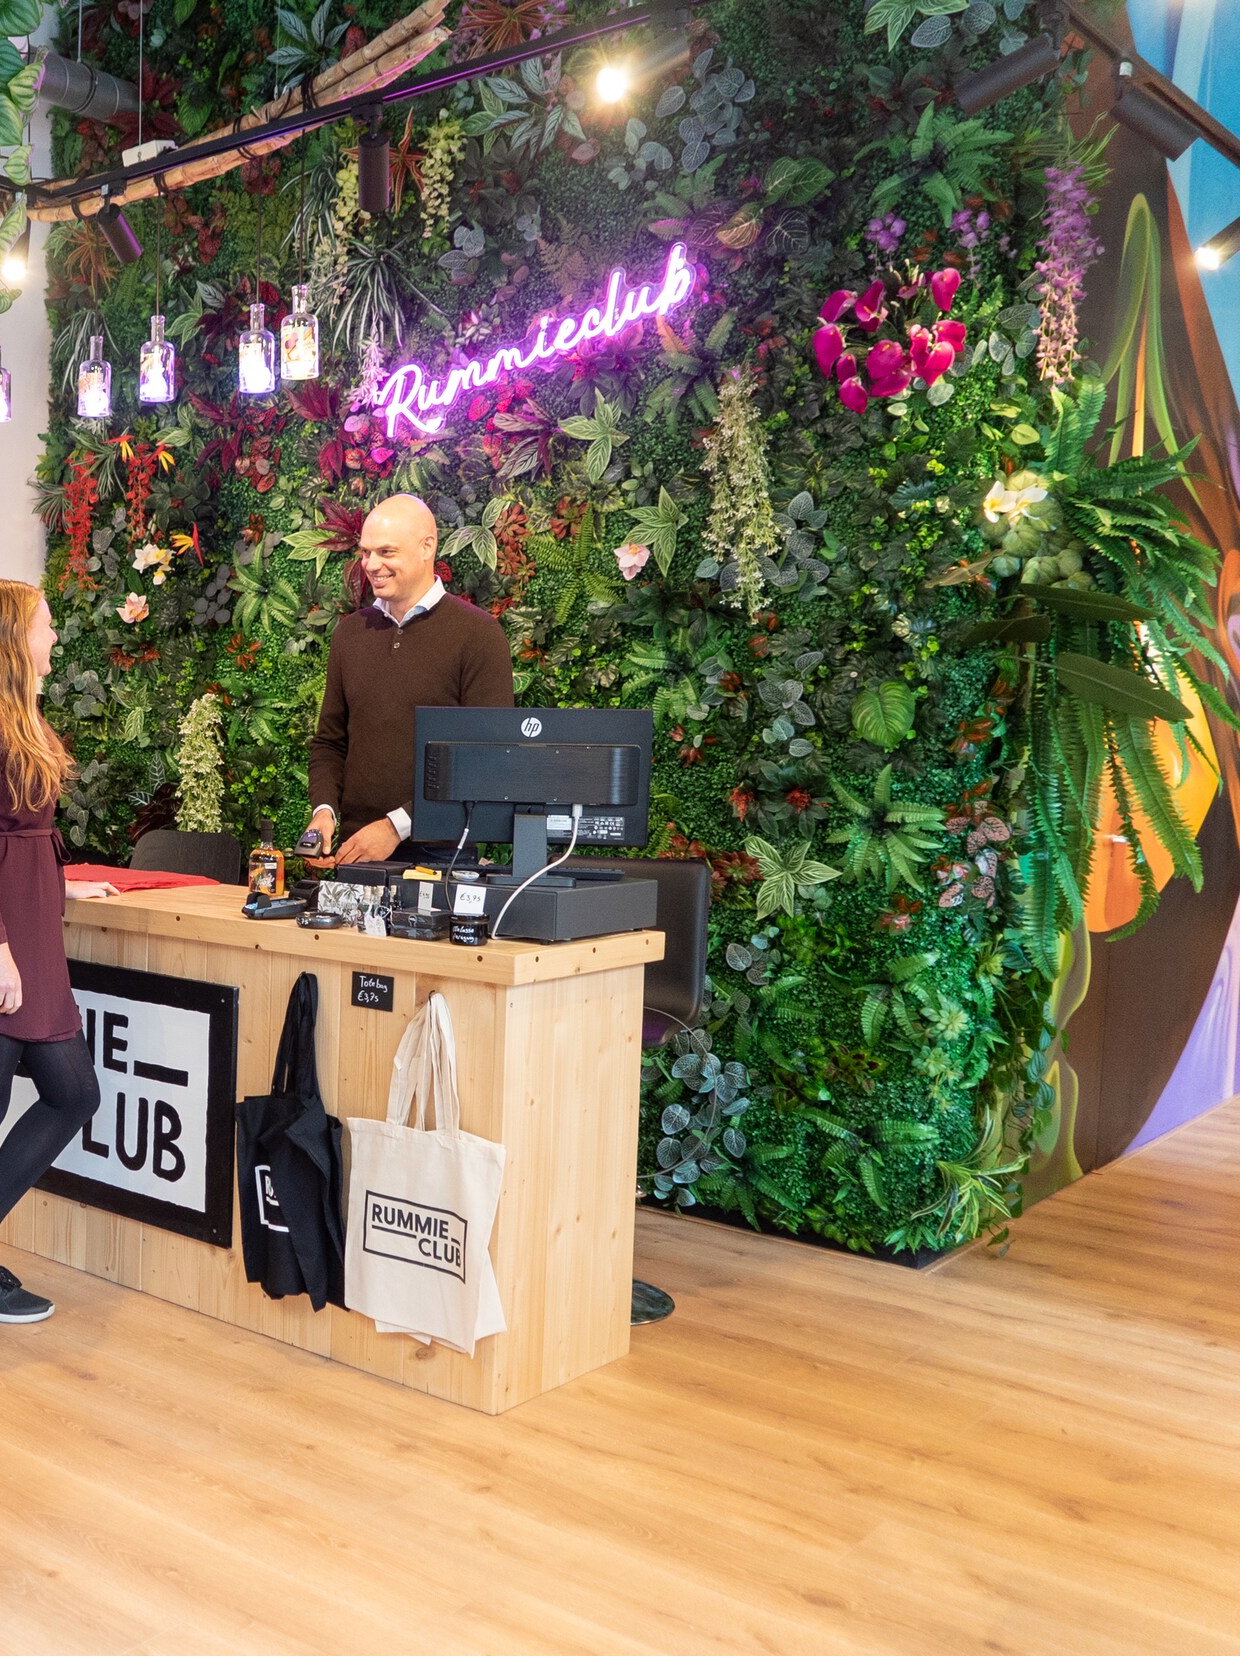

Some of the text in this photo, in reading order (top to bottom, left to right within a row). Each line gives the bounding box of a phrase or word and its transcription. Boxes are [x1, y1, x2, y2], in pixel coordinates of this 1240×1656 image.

[372, 244, 692, 438] Rummieclub
[82, 1091, 187, 1183] LUB
[371, 1202, 449, 1240] RUMMIE
[417, 1236, 462, 1268] CLUB
